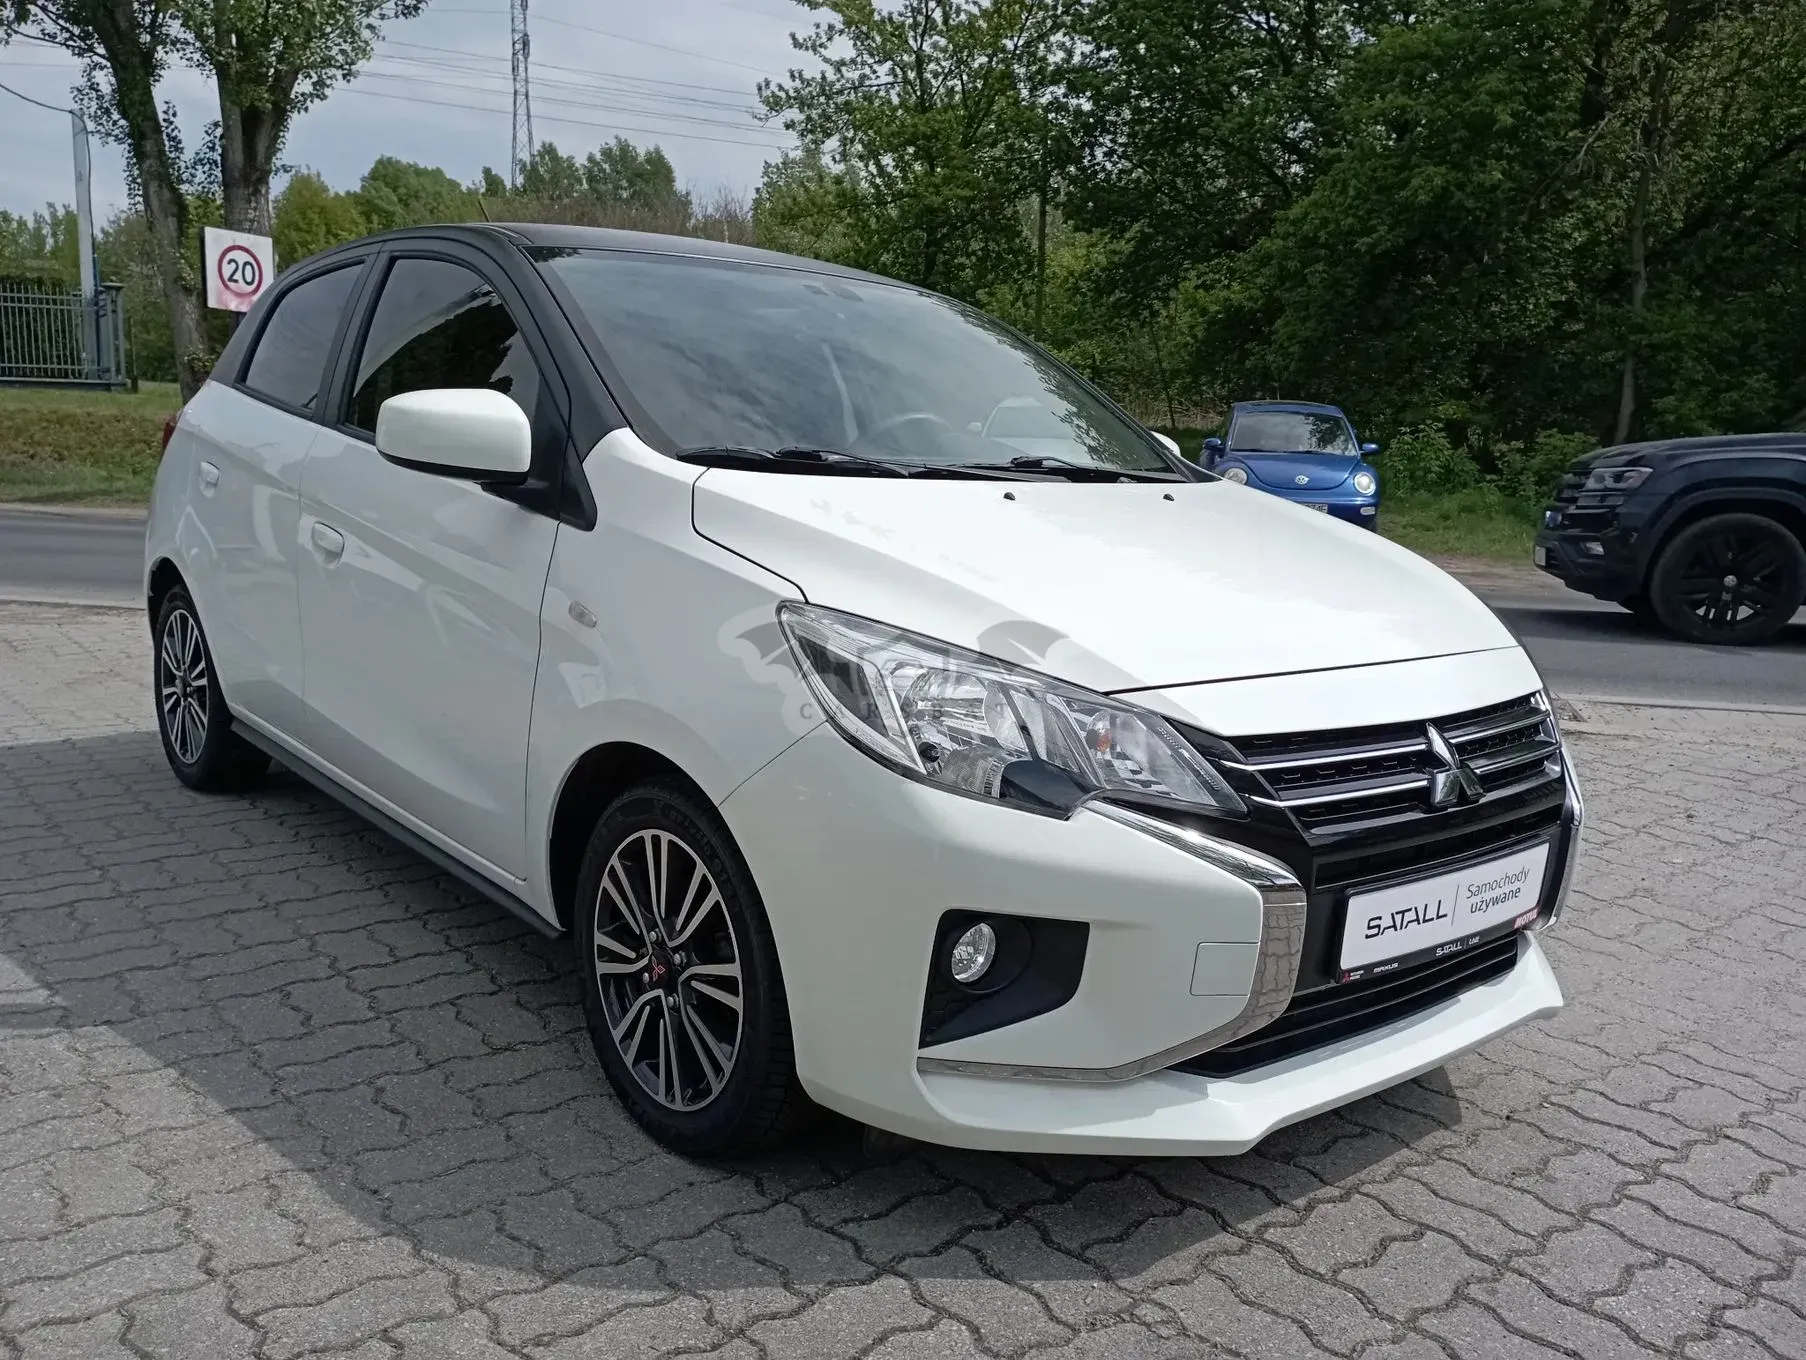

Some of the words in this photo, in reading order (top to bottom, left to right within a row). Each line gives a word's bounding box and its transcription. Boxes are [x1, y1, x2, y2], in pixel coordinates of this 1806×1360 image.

[227, 258, 256, 286] 20
[1466, 866, 1530, 900] Samochody
[1470, 886, 1521, 914] używane
[1364, 898, 1449, 940] SATALL
[1373, 962, 1399, 974] MAXUS
